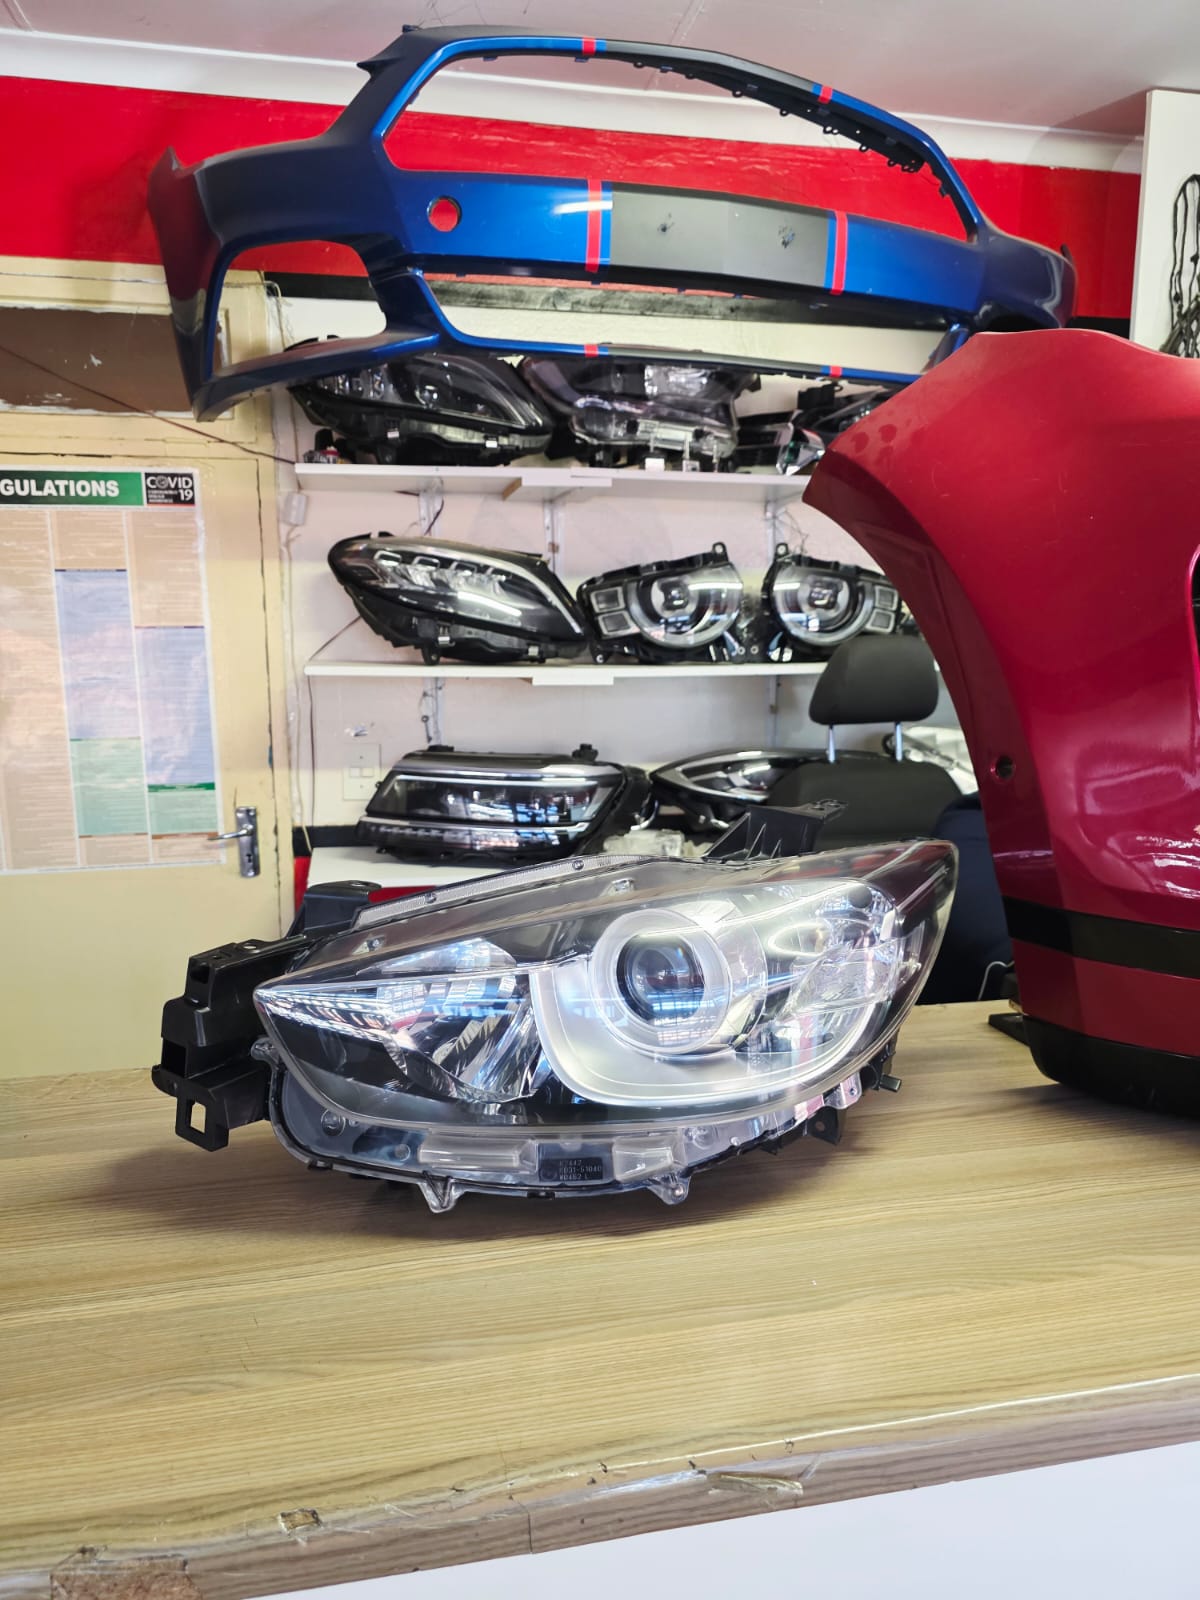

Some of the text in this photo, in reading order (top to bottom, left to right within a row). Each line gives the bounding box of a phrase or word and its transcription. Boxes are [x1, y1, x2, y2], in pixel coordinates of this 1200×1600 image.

[0, 479, 120, 497] GULATIONS
[146, 475, 193, 489] COVID
[179, 489, 193, 501] 19
